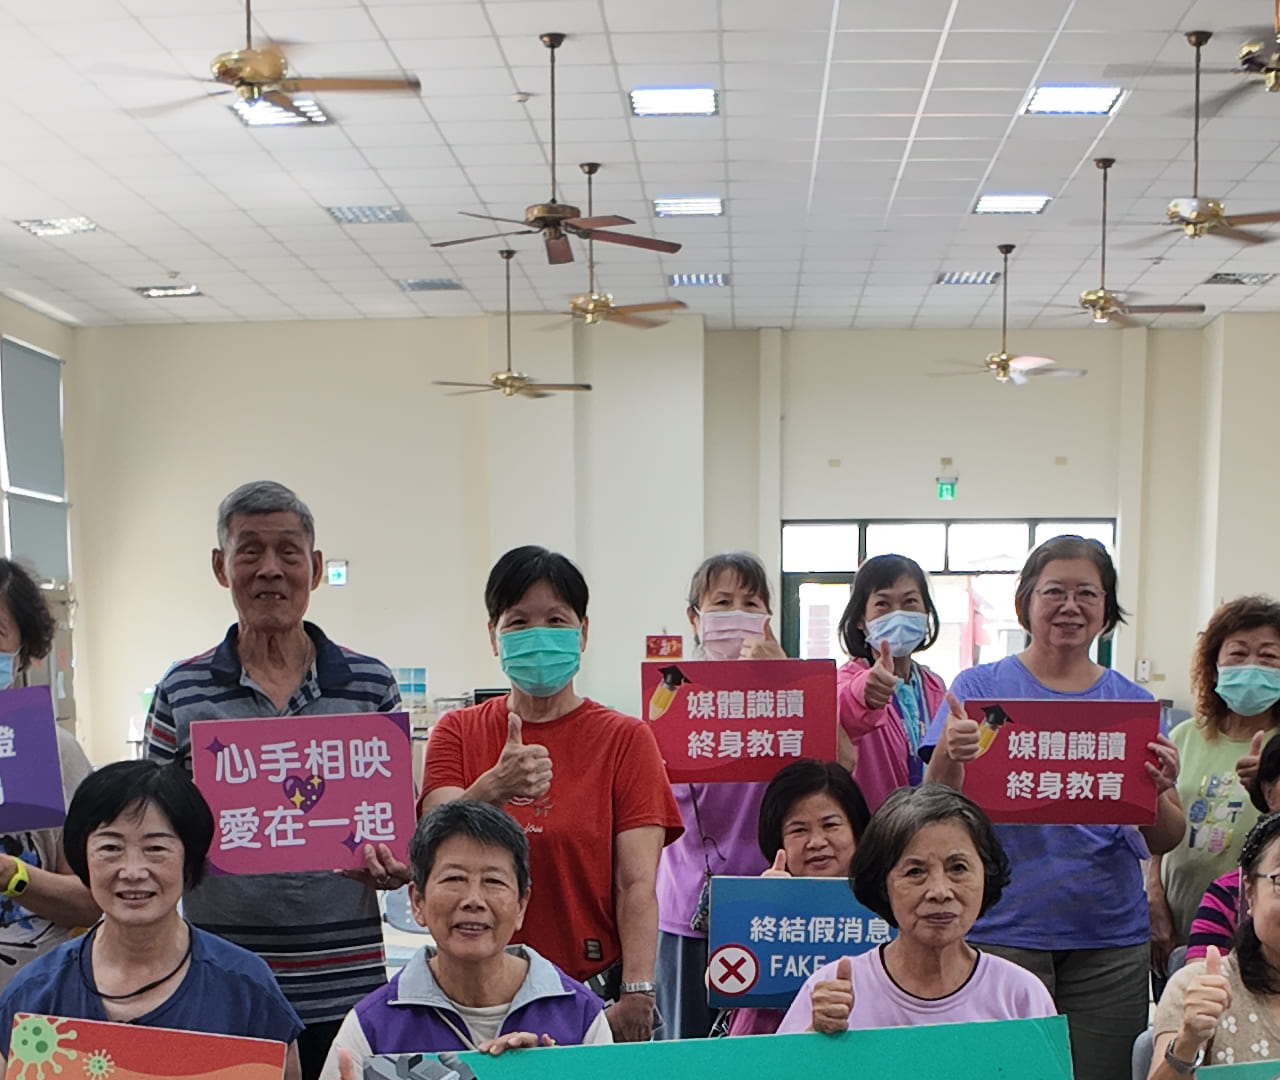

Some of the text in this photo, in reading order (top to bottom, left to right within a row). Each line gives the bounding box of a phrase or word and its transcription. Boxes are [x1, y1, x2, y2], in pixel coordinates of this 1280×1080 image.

[687, 688, 805, 721] 媒體識讀
[215, 735, 393, 785] 心手相映
[687, 728, 804, 760] 終身教育
[1007, 730, 1126, 762] 媒體識讀
[1006, 770, 1125, 802] 終身教育
[218, 800, 397, 851] 愛在一起
[749, 915, 892, 944] 終結假消息
